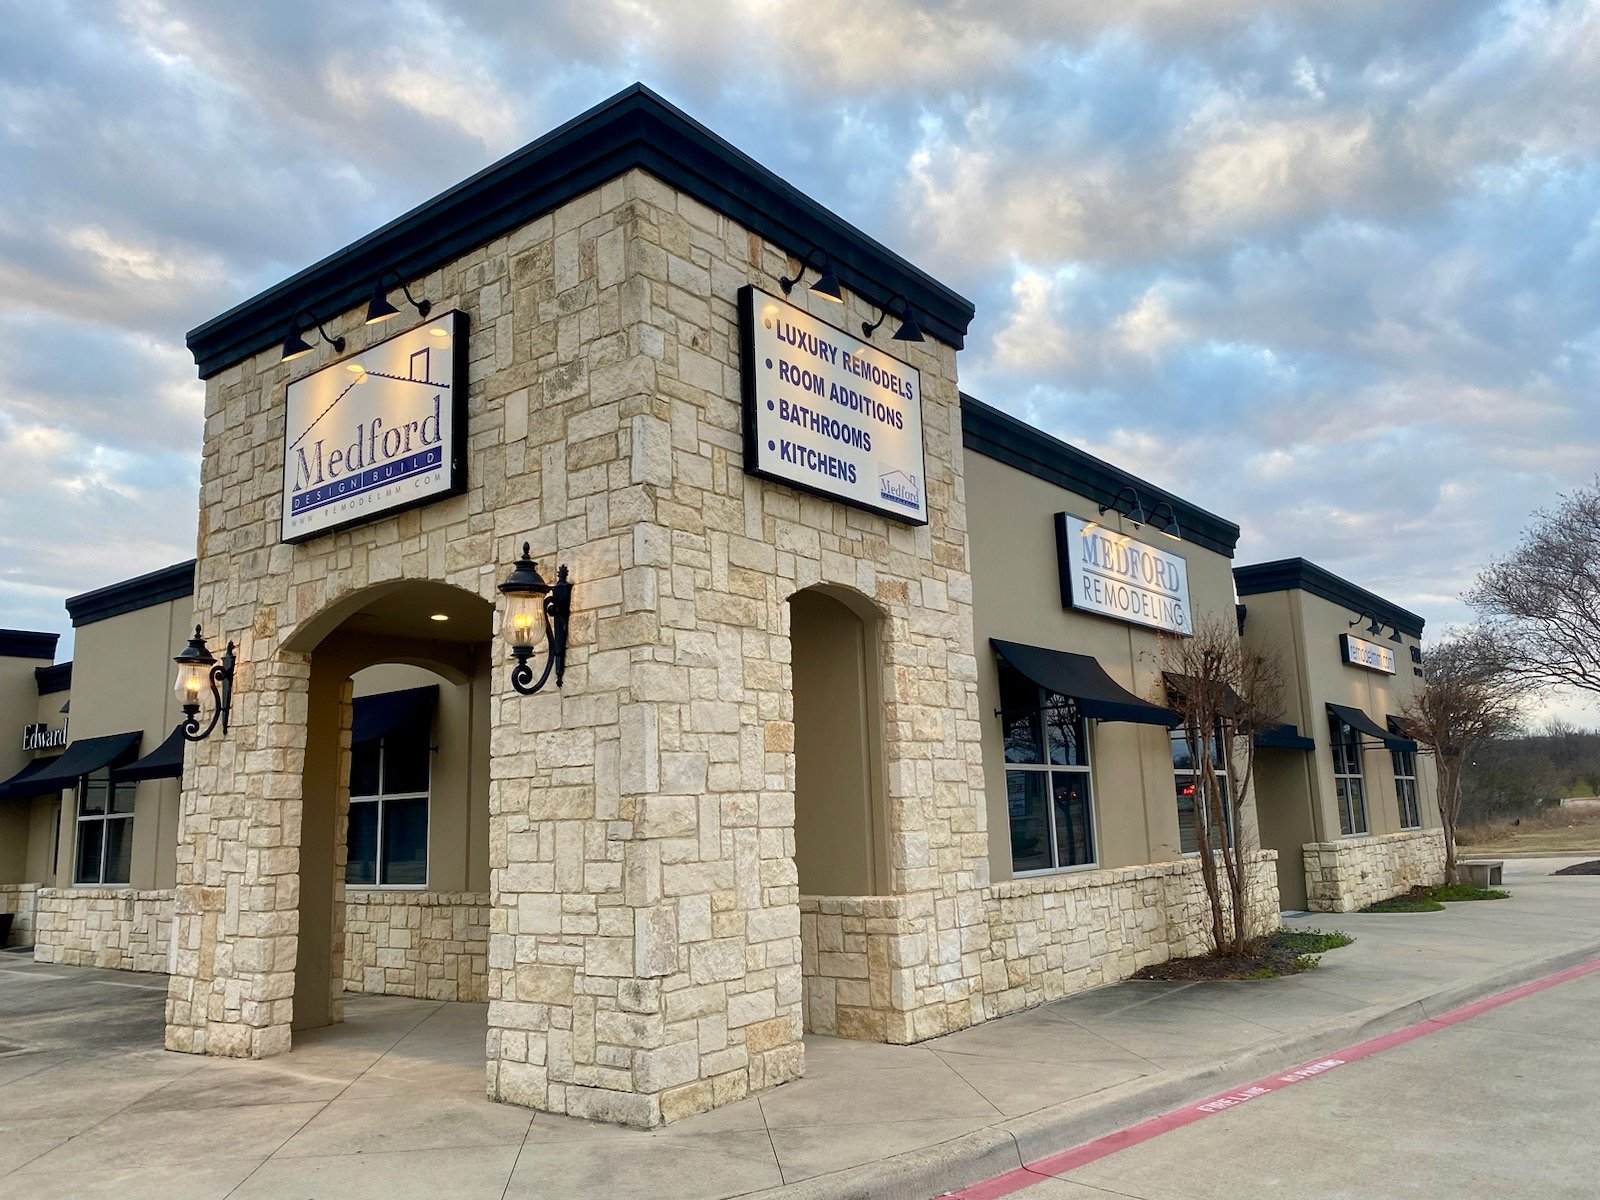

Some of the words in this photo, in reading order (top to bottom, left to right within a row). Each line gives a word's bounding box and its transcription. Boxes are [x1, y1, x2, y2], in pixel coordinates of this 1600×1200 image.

[776, 318, 838, 365] LUXURY
[843, 350, 914, 401] REMODELS
[779, 359, 825, 398] ROOM
[830, 382, 904, 431] ADDITIONS
[292, 394, 443, 493] Medford
[779, 398, 872, 452] BATHROOMS
[294, 478, 358, 509] DESIGN
[372, 452, 435, 482] BUILD
[780, 439, 857, 484] KITCHENS
[881, 478, 919, 504] Medford
[1081, 533, 1180, 593] MEDFORD
[1083, 575, 1184, 626] REMODELING
[22, 717, 69, 751] Edward
